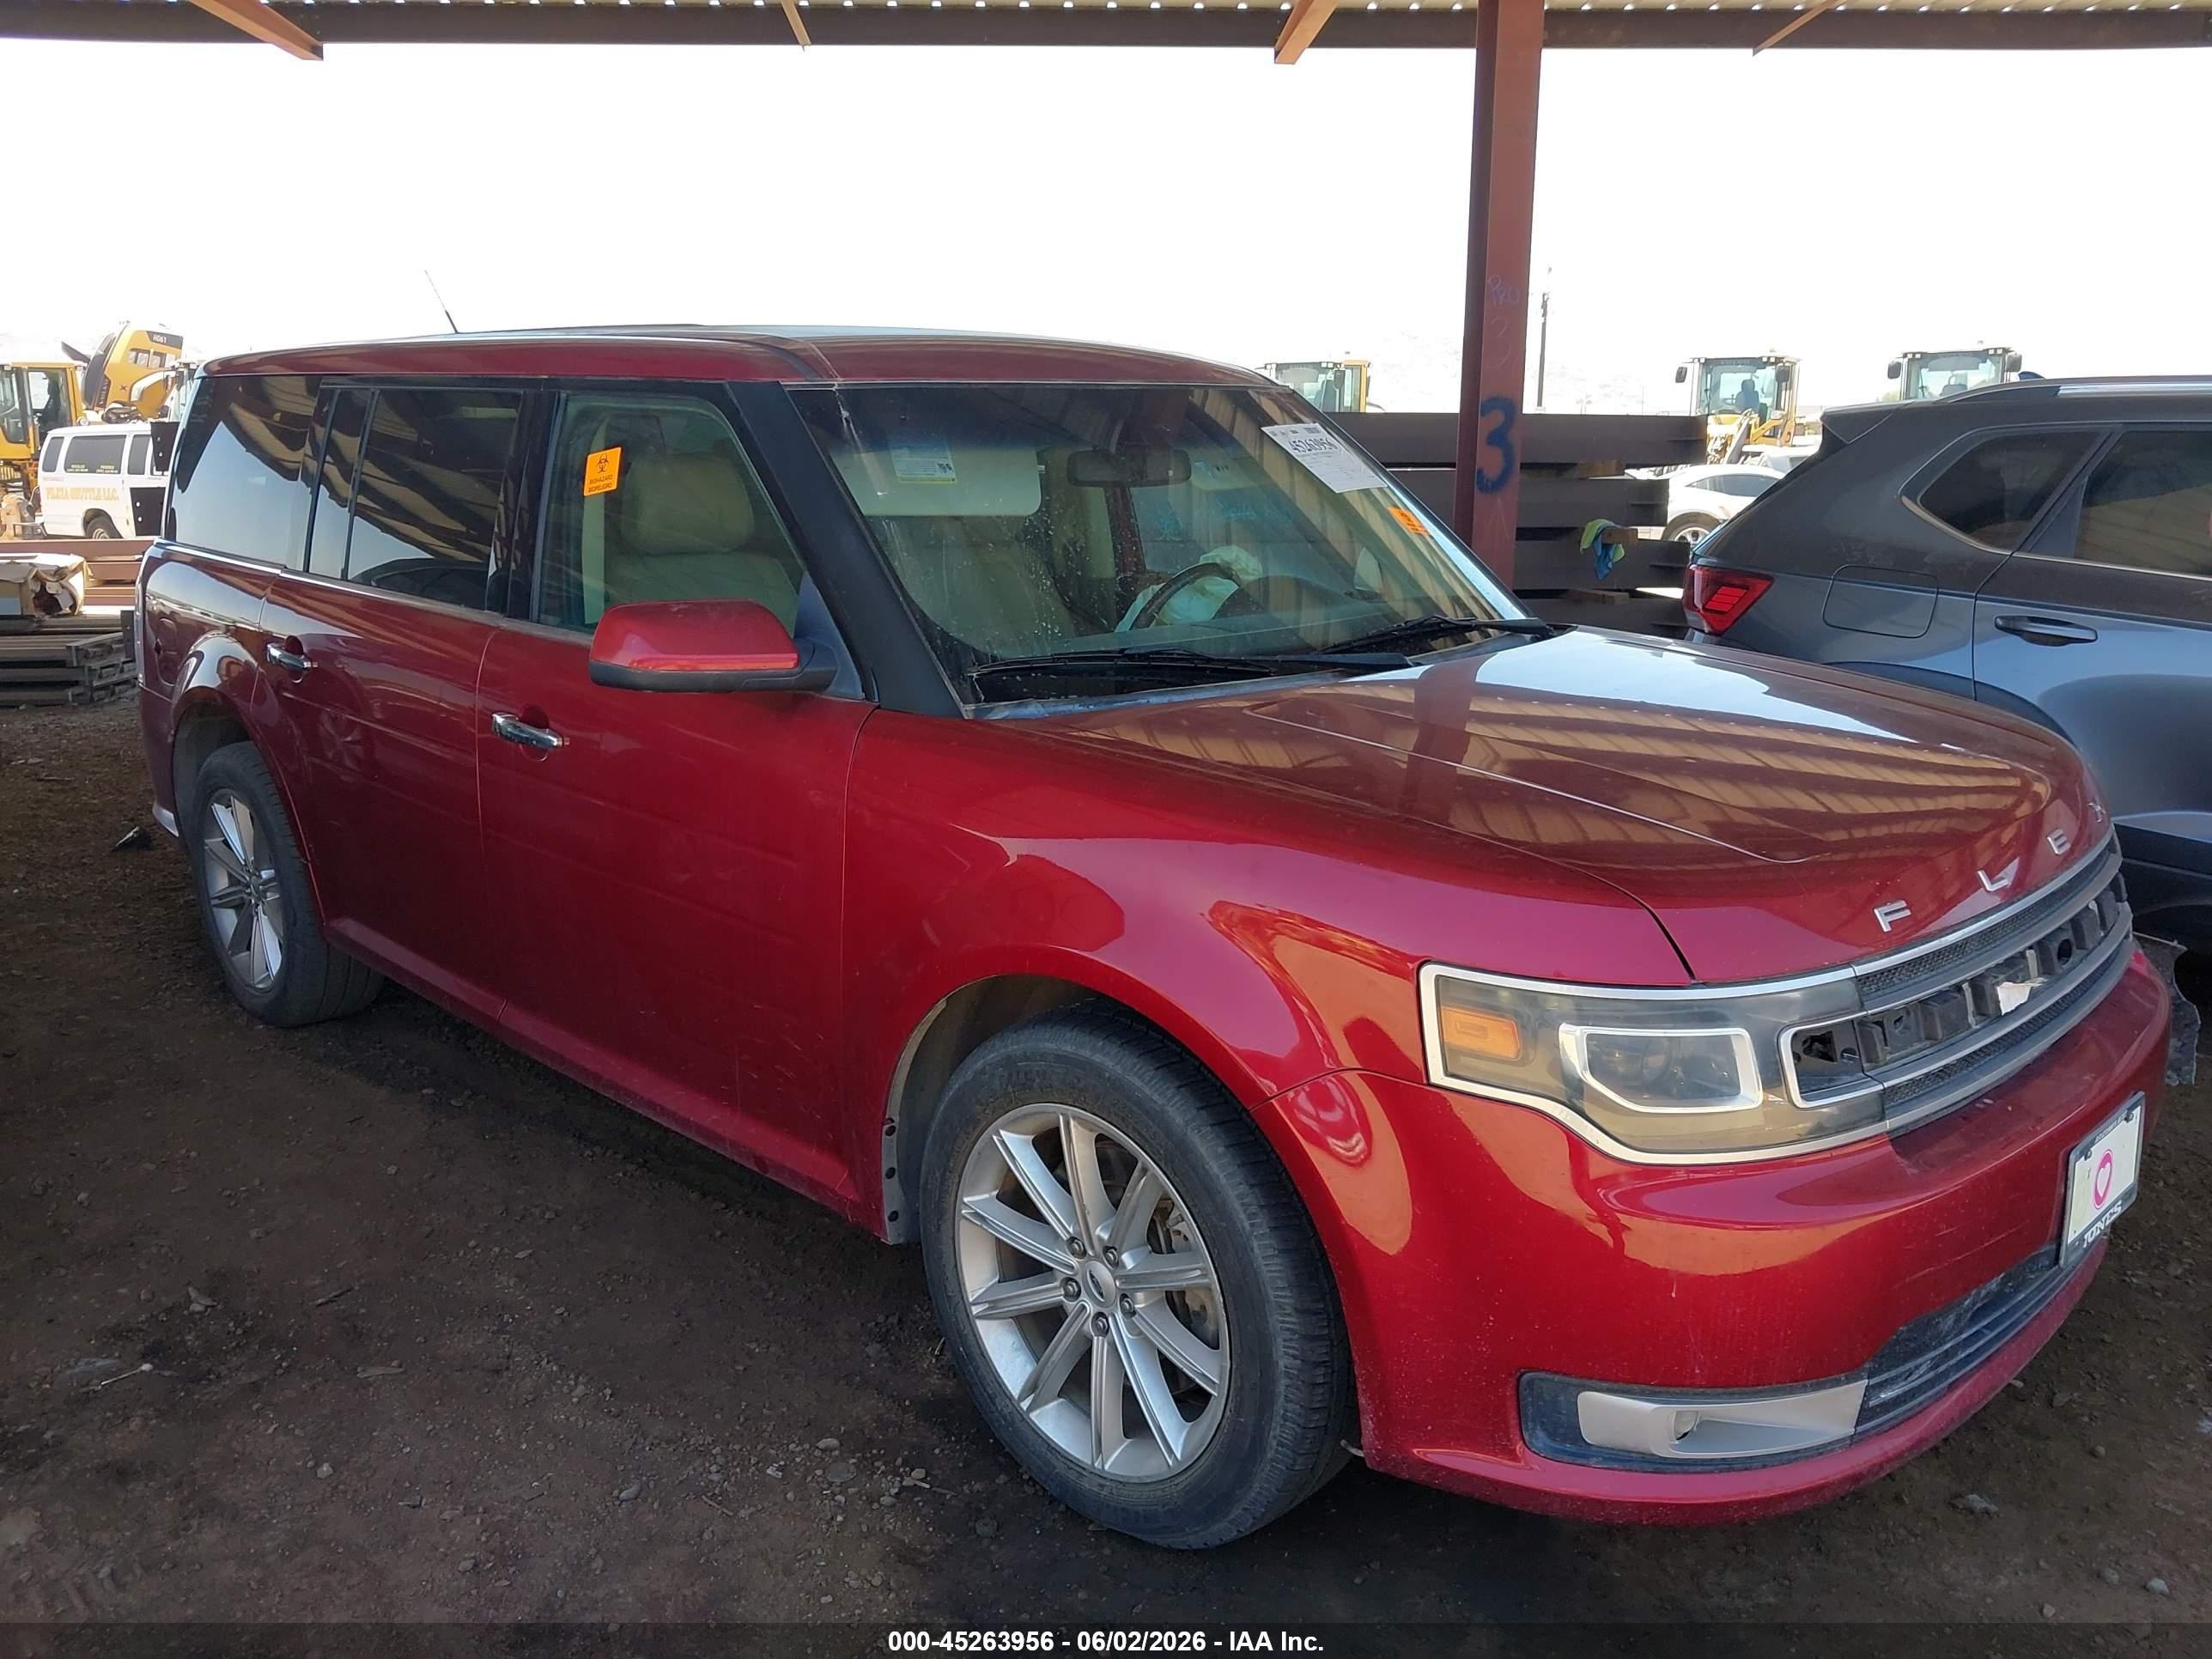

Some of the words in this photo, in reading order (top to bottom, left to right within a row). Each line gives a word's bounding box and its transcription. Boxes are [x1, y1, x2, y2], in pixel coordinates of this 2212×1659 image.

[1289, 436, 1339, 453] 45263956
[1475, 393, 1516, 494] 3
[589, 474, 613, 485] BIOHAZARD
[2082, 1200, 2123, 1248] JONES
